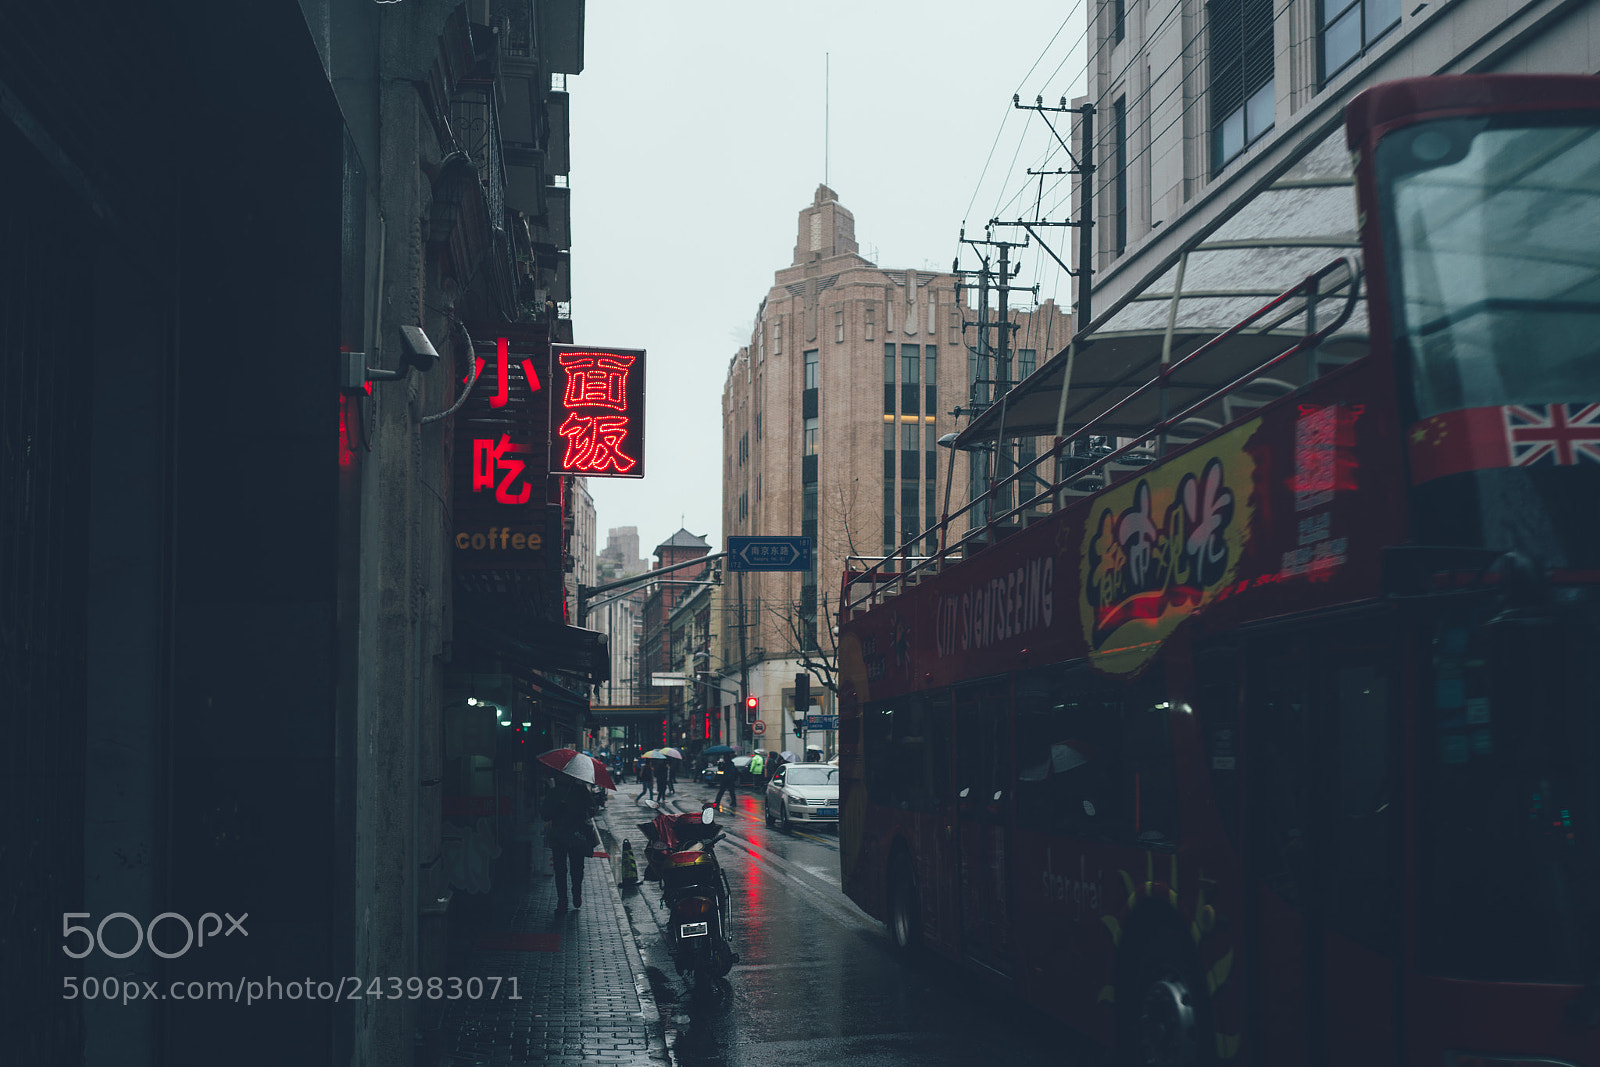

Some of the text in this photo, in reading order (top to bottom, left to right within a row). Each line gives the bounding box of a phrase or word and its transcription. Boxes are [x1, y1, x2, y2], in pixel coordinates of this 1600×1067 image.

[462, 337, 541, 504] 小吃
[558, 352, 637, 472] 面饭
[455, 527, 543, 550] coffee
[751, 546, 789, 556] 南京东路
[937, 593, 959, 659] CITY
[962, 556, 1054, 650] SIGHTSEEING
